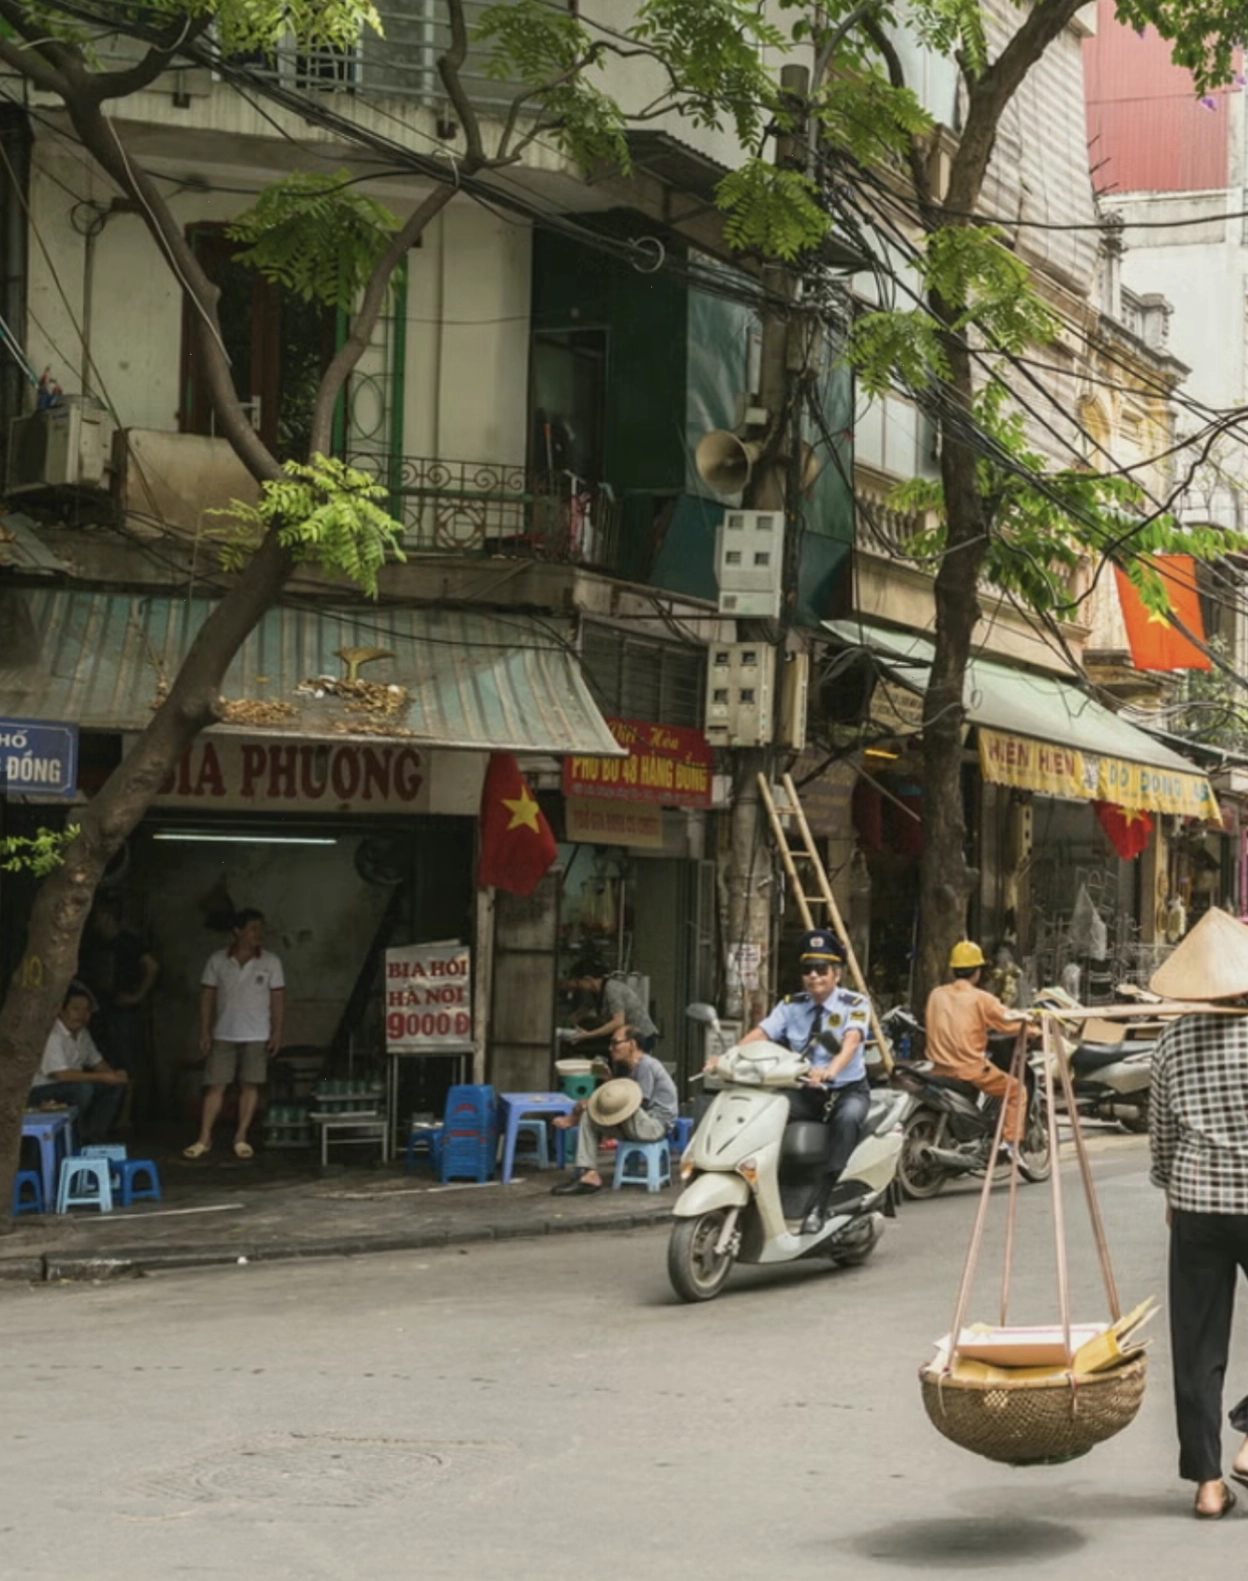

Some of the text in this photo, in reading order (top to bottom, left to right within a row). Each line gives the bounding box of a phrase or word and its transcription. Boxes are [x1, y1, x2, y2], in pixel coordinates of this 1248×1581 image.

[0, 729, 28, 748] HỐ
[388, 961, 426, 979] BIA
[388, 983, 463, 1010] HÀ NỘI
[387, 1012, 450, 1040] 9000
